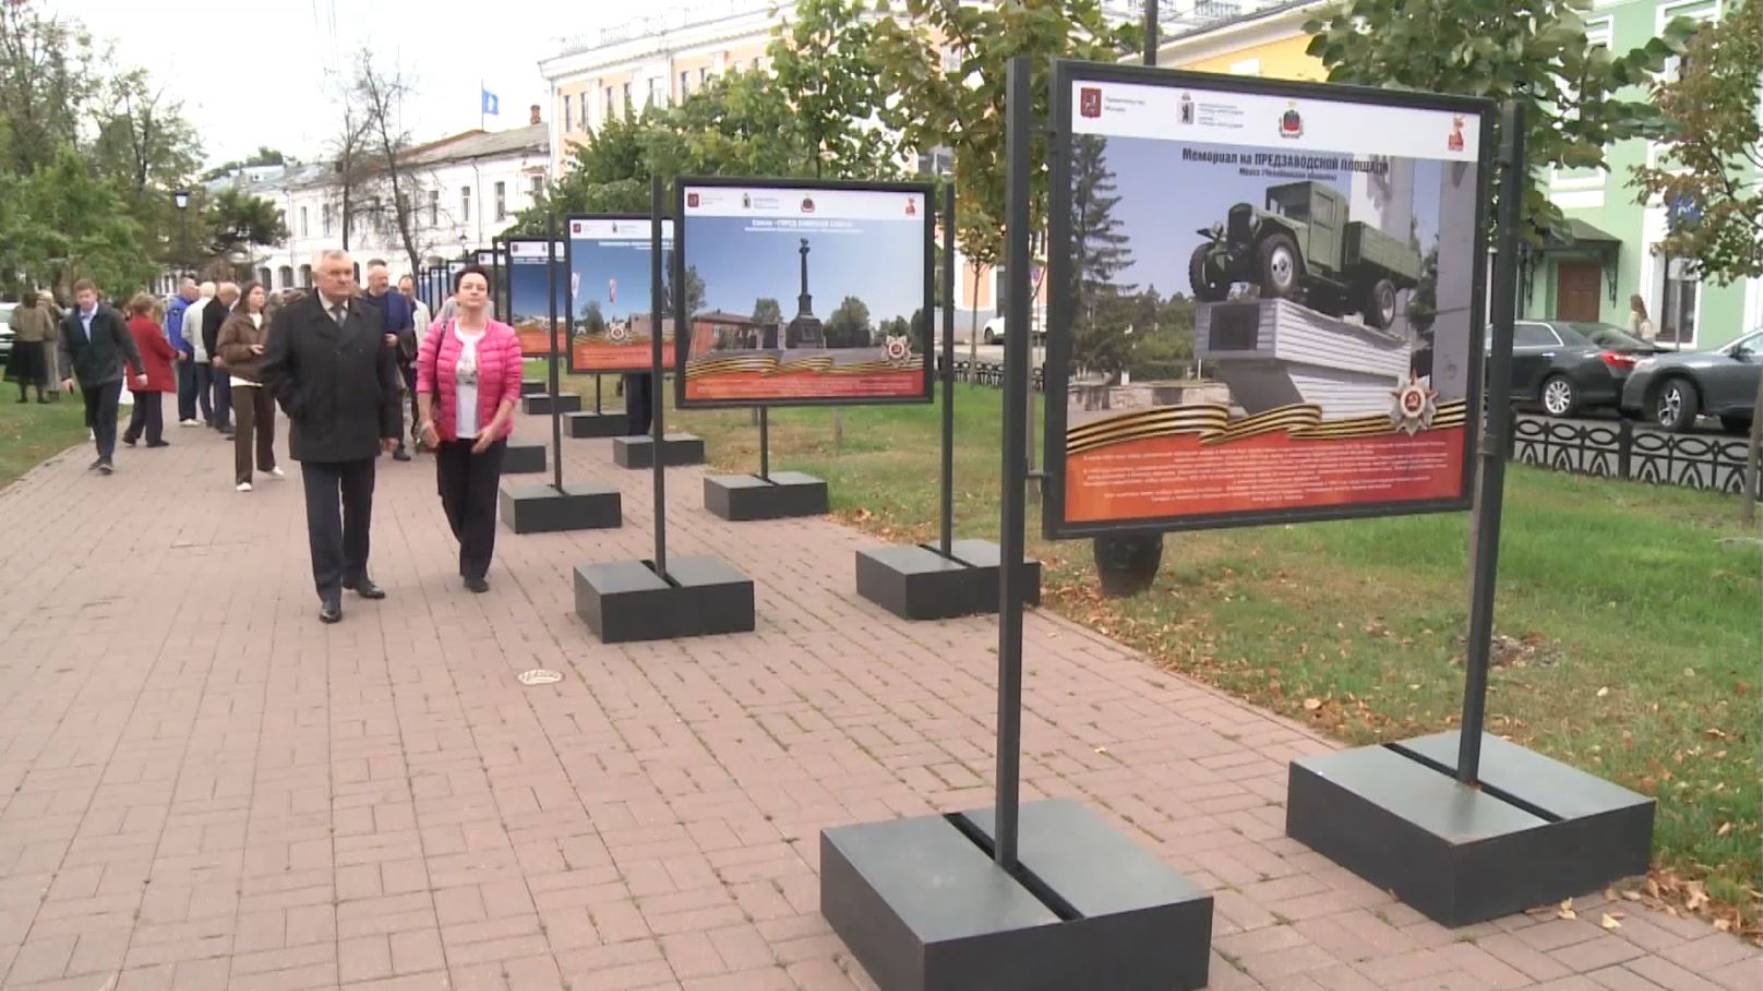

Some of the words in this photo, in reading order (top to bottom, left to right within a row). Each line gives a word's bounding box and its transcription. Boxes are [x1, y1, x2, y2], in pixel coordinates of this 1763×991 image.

[1182, 148, 1237, 165] Мемориал
[1240, 153, 1252, 165] на
[1255, 153, 1338, 170] ПРЕДЗАВОДСКОЙ
